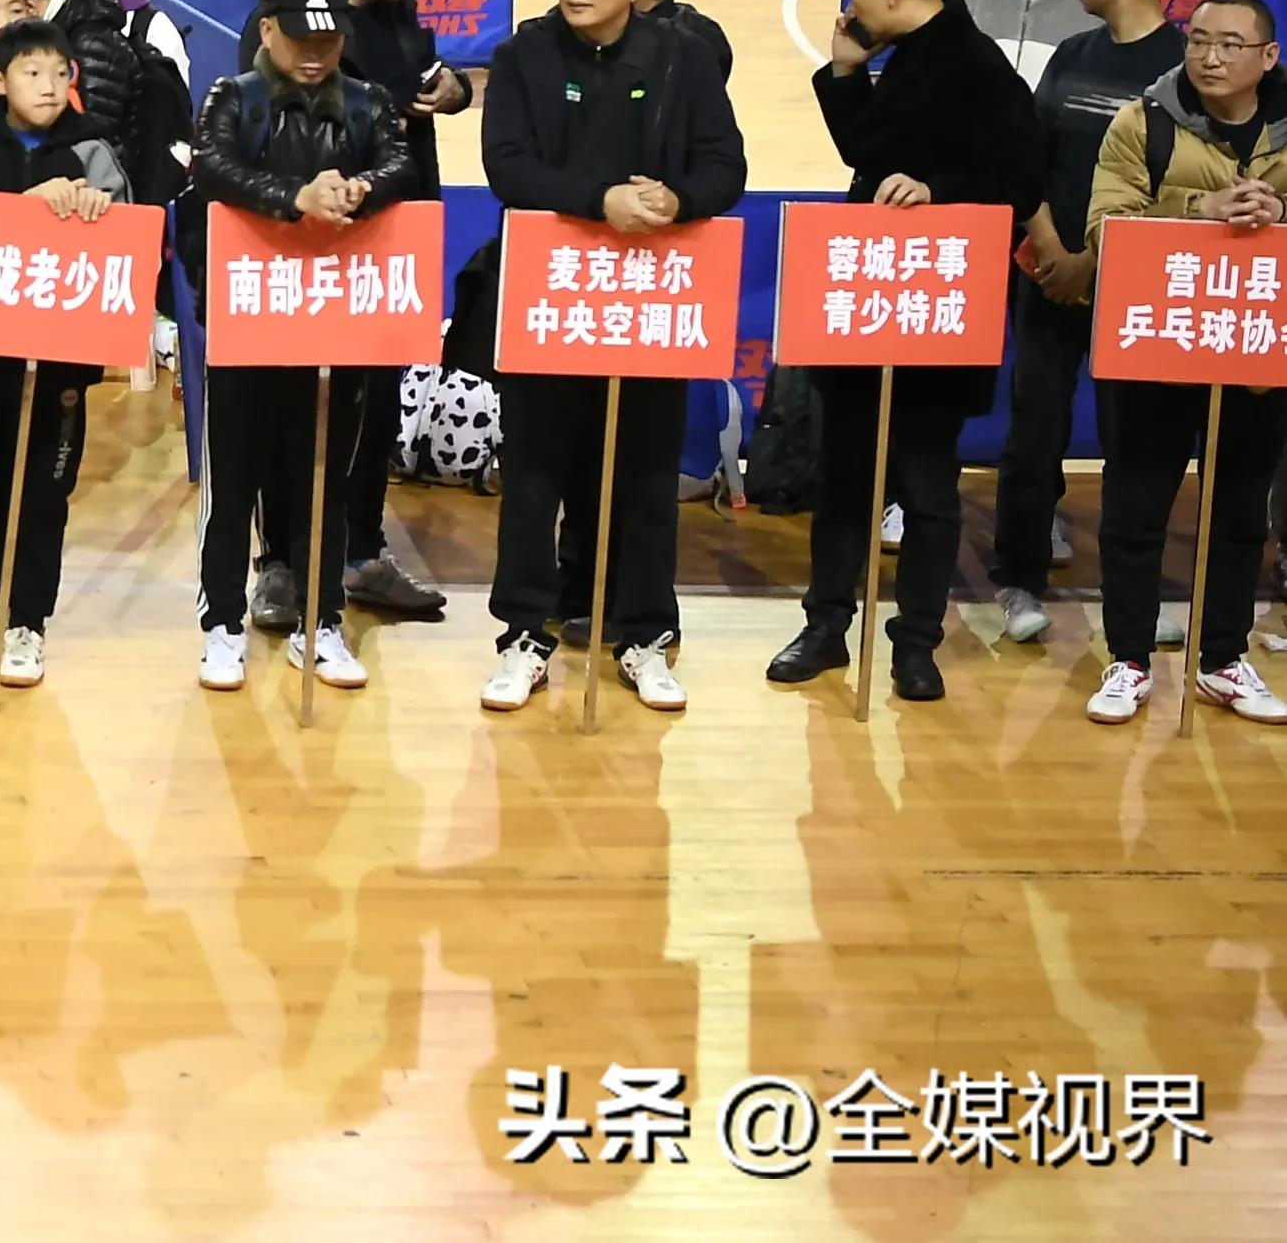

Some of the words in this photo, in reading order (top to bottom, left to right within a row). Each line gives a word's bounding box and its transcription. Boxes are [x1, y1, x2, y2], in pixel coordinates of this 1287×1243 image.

[548, 245, 693, 295] 麦克维尔
[827, 235, 969, 282] 蓉城乒事
[1165, 251, 1282, 302] 营山县
[227, 253, 424, 316] 南部乒协队
[527, 298, 709, 349] 中央空调队
[822, 289, 966, 336] 青少特成
[1118, 304, 1287, 355] 乒乓球协
